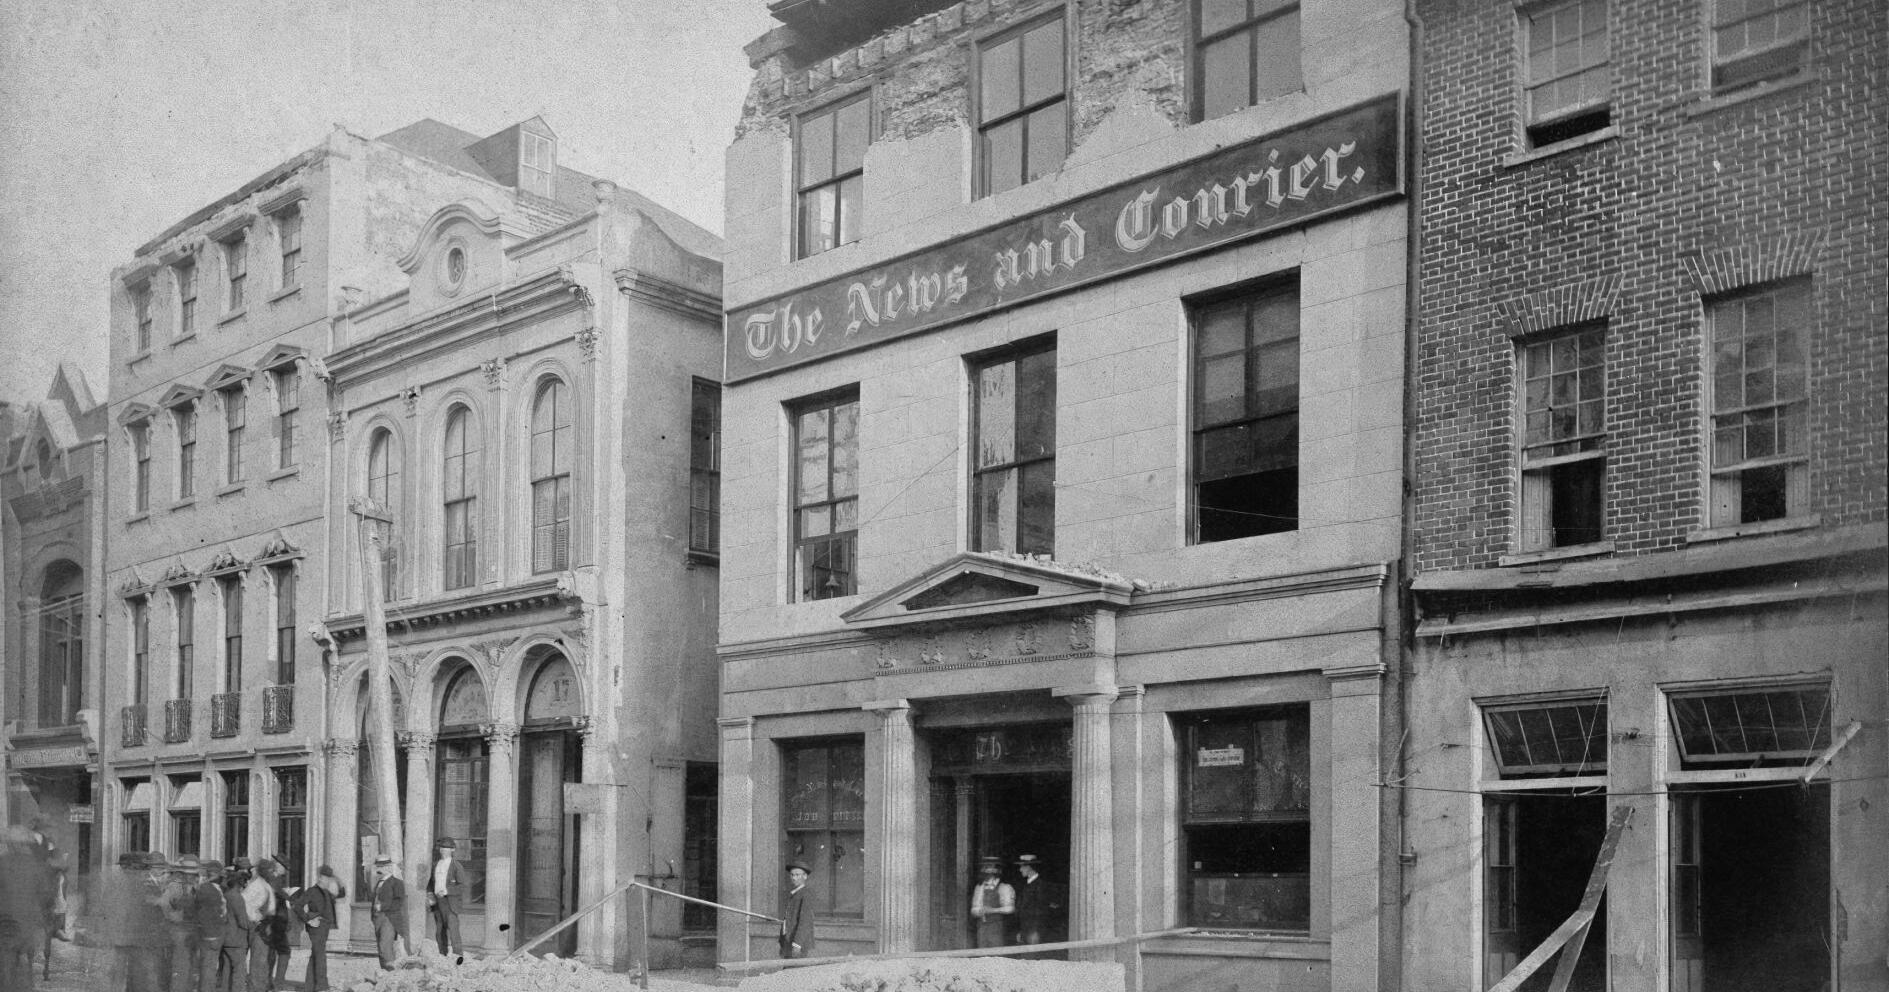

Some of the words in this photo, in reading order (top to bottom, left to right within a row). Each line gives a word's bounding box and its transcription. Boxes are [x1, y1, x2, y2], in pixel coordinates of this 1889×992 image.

[744, 302, 825, 360] The
[845, 263, 968, 336] News
[993, 212, 1087, 290] and
[1115, 140, 1366, 253] Courier.
[552, 679, 571, 702] 17
